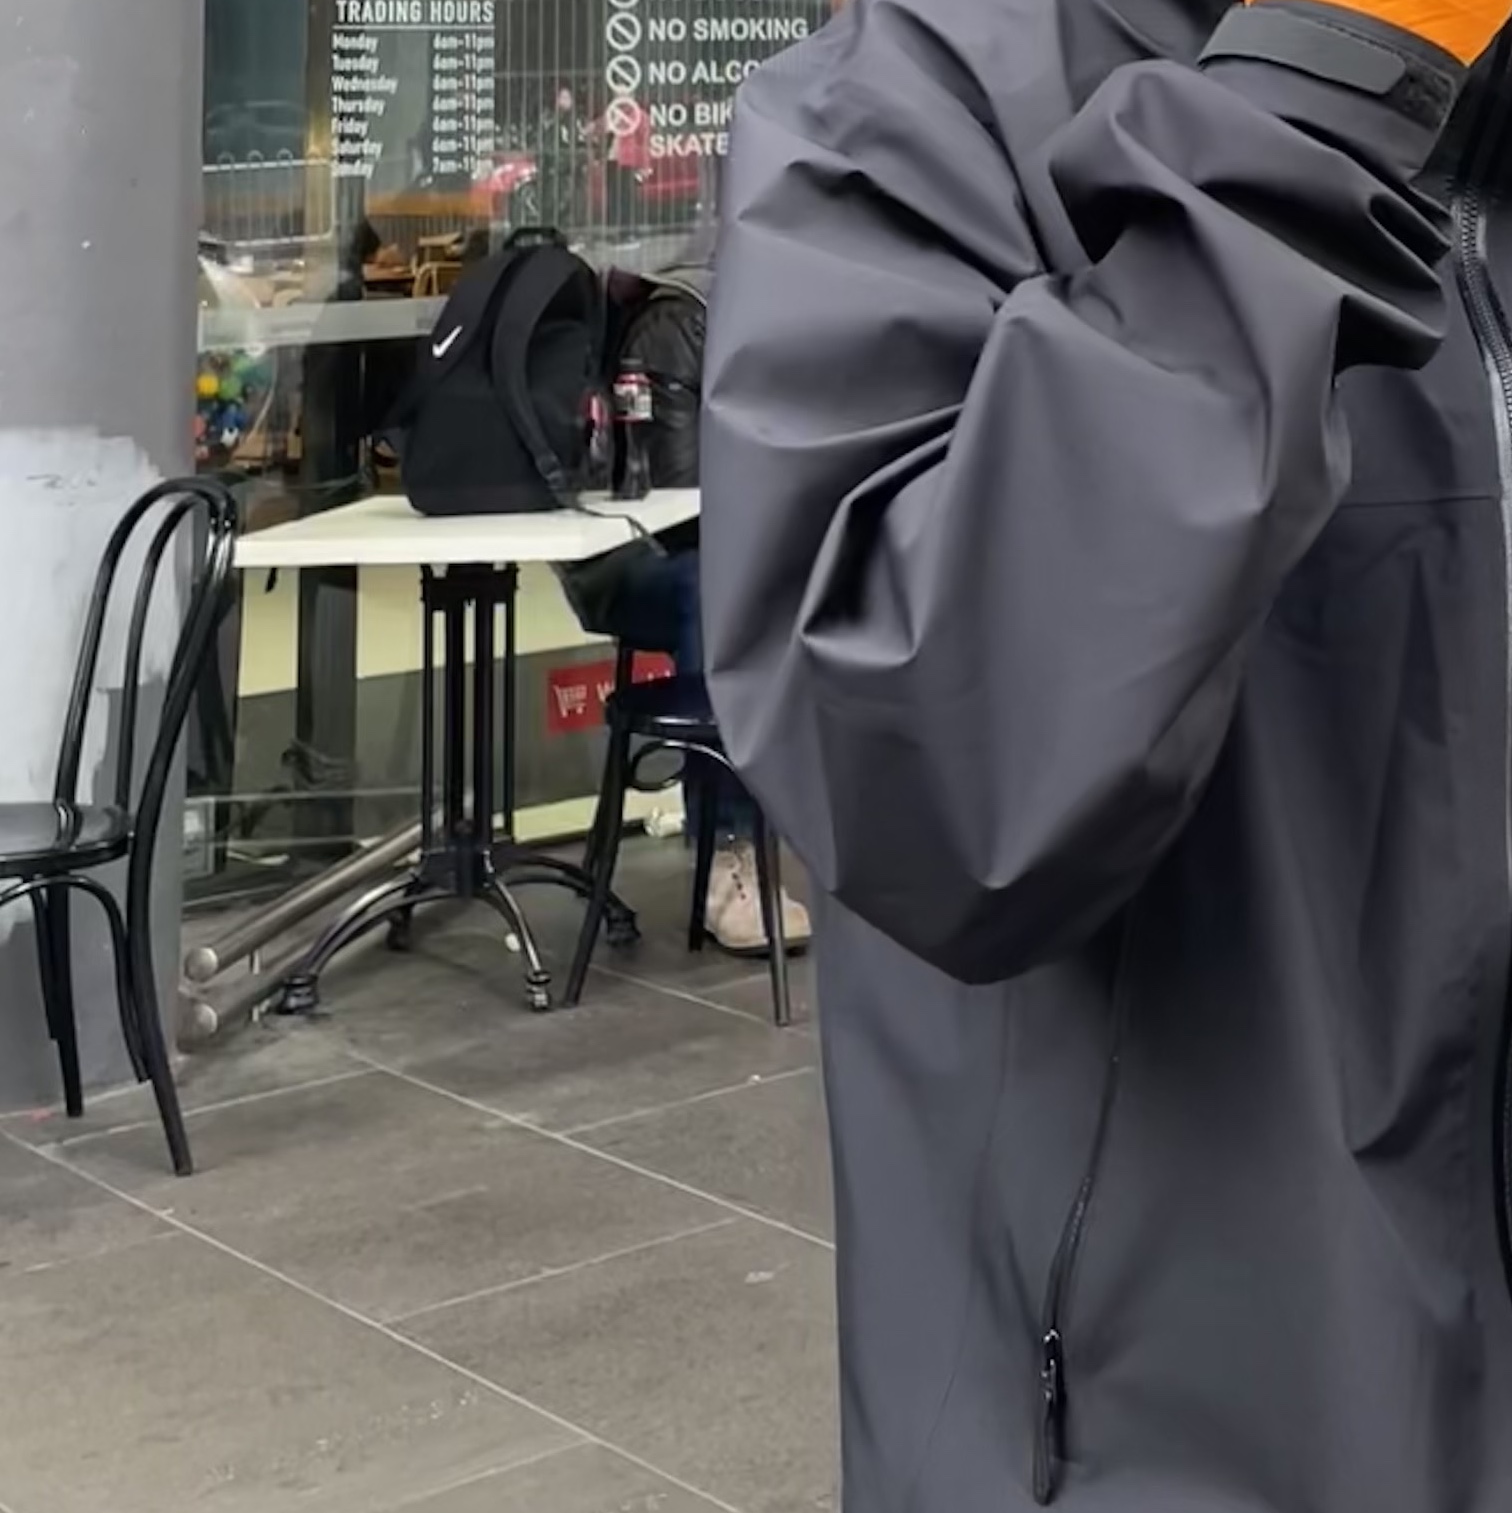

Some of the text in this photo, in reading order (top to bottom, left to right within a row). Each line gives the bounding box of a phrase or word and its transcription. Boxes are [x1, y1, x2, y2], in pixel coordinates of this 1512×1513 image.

[335, 0, 495, 23] TRADING HOURS
[649, 18, 809, 41] NO SMOKING
[331, 33, 379, 53] Monday
[331, 54, 380, 74] Tuesday
[649, 61, 687, 84] NO
[331, 74, 398, 95] Wednesday
[331, 96, 386, 117] Thursday
[650, 104, 687, 127] NO
[331, 116, 369, 137] Friday
